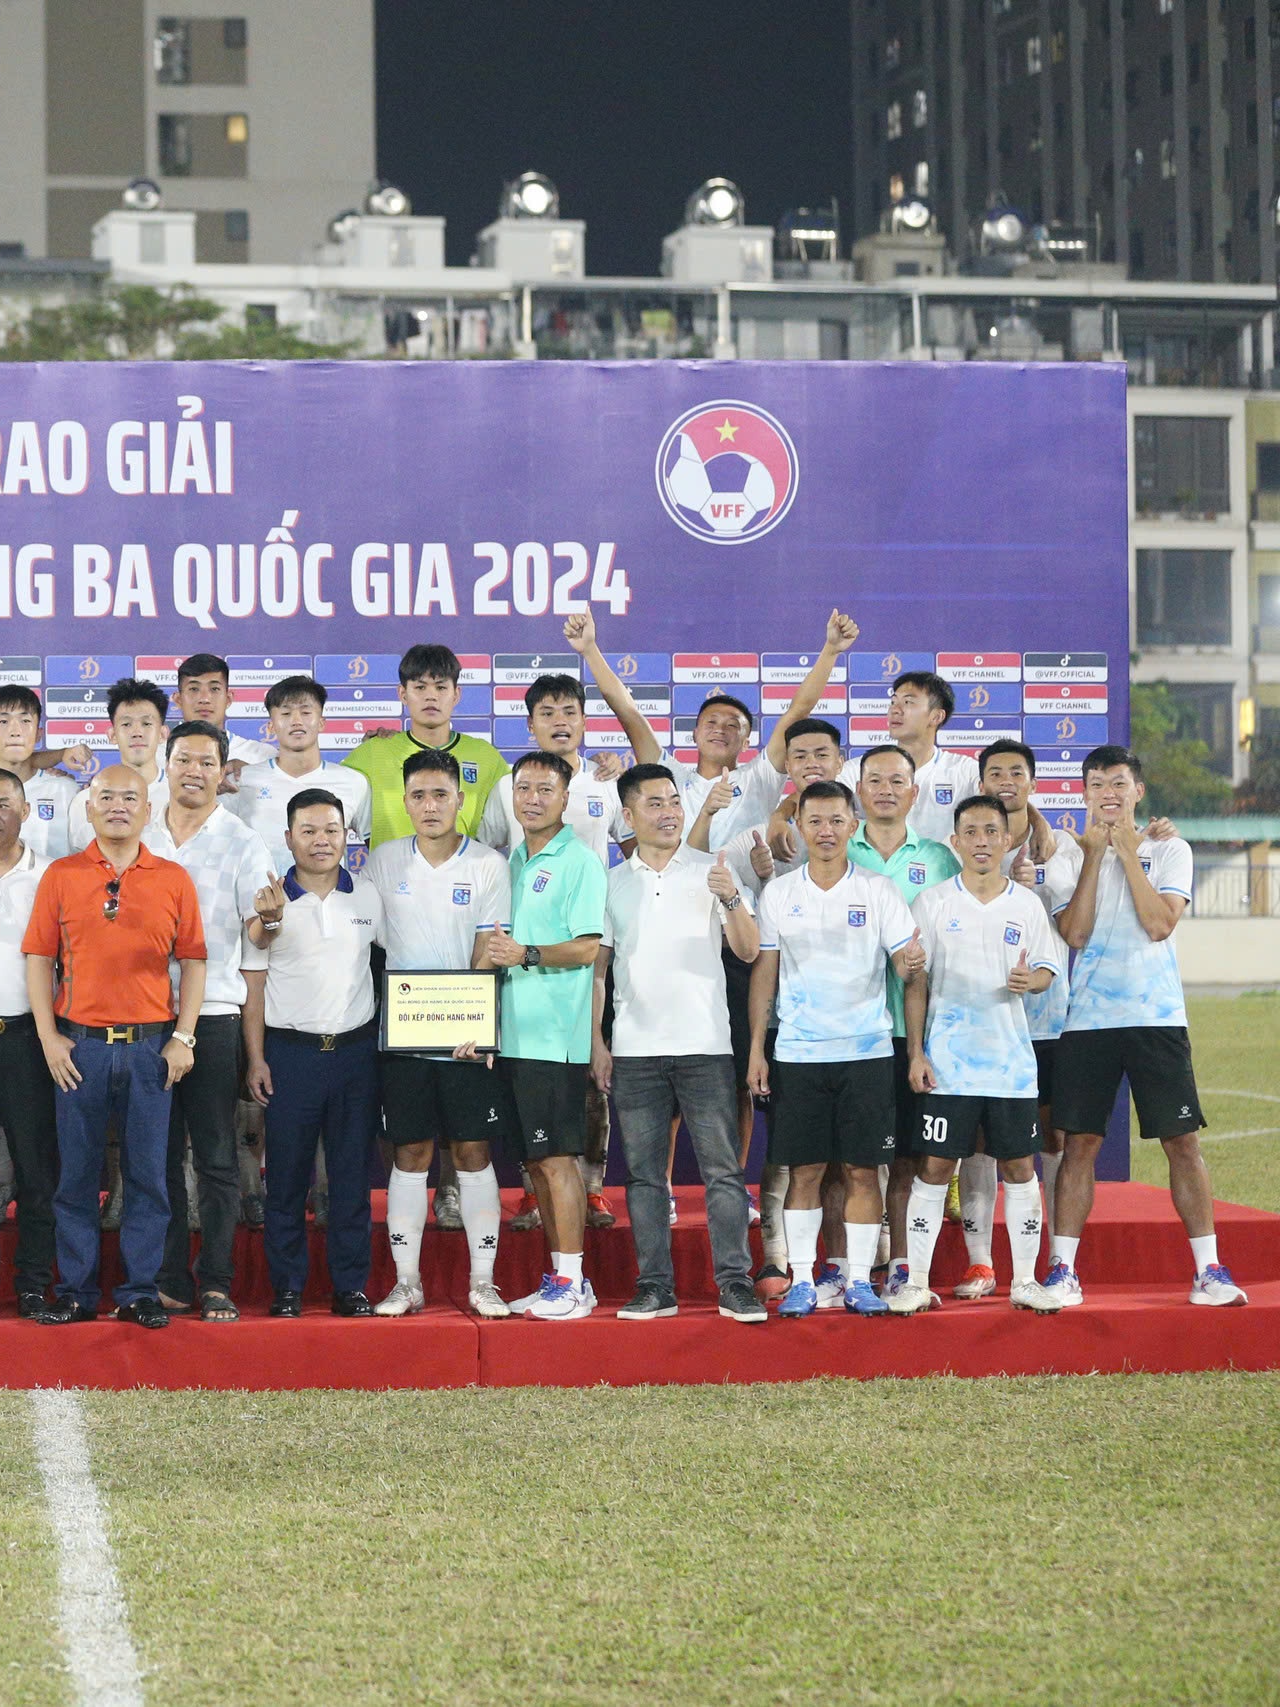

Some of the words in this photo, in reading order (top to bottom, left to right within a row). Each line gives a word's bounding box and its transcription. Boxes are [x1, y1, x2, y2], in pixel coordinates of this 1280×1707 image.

[106, 395, 233, 496] GIẢI
[710, 503, 745, 519] VFF
[73, 544, 157, 618] BA
[173, 509, 334, 629] QUỐC
[351, 542, 458, 618] GIA
[473, 541, 631, 617] 2024
[691, 671, 740, 679] VFF.ORG.VN
[1035, 670, 1096, 679] @VFF.OFFICIAL
[58, 705, 107, 714] @VFF.OFFIC
[1040, 702, 1055, 710] VFF
[1055, 702, 1092, 710] CHANNEL
[600, 735, 615, 743] VFF
[1043, 797, 1084, 805] VFF.ORG.V
[922, 1114, 948, 1143] 30
